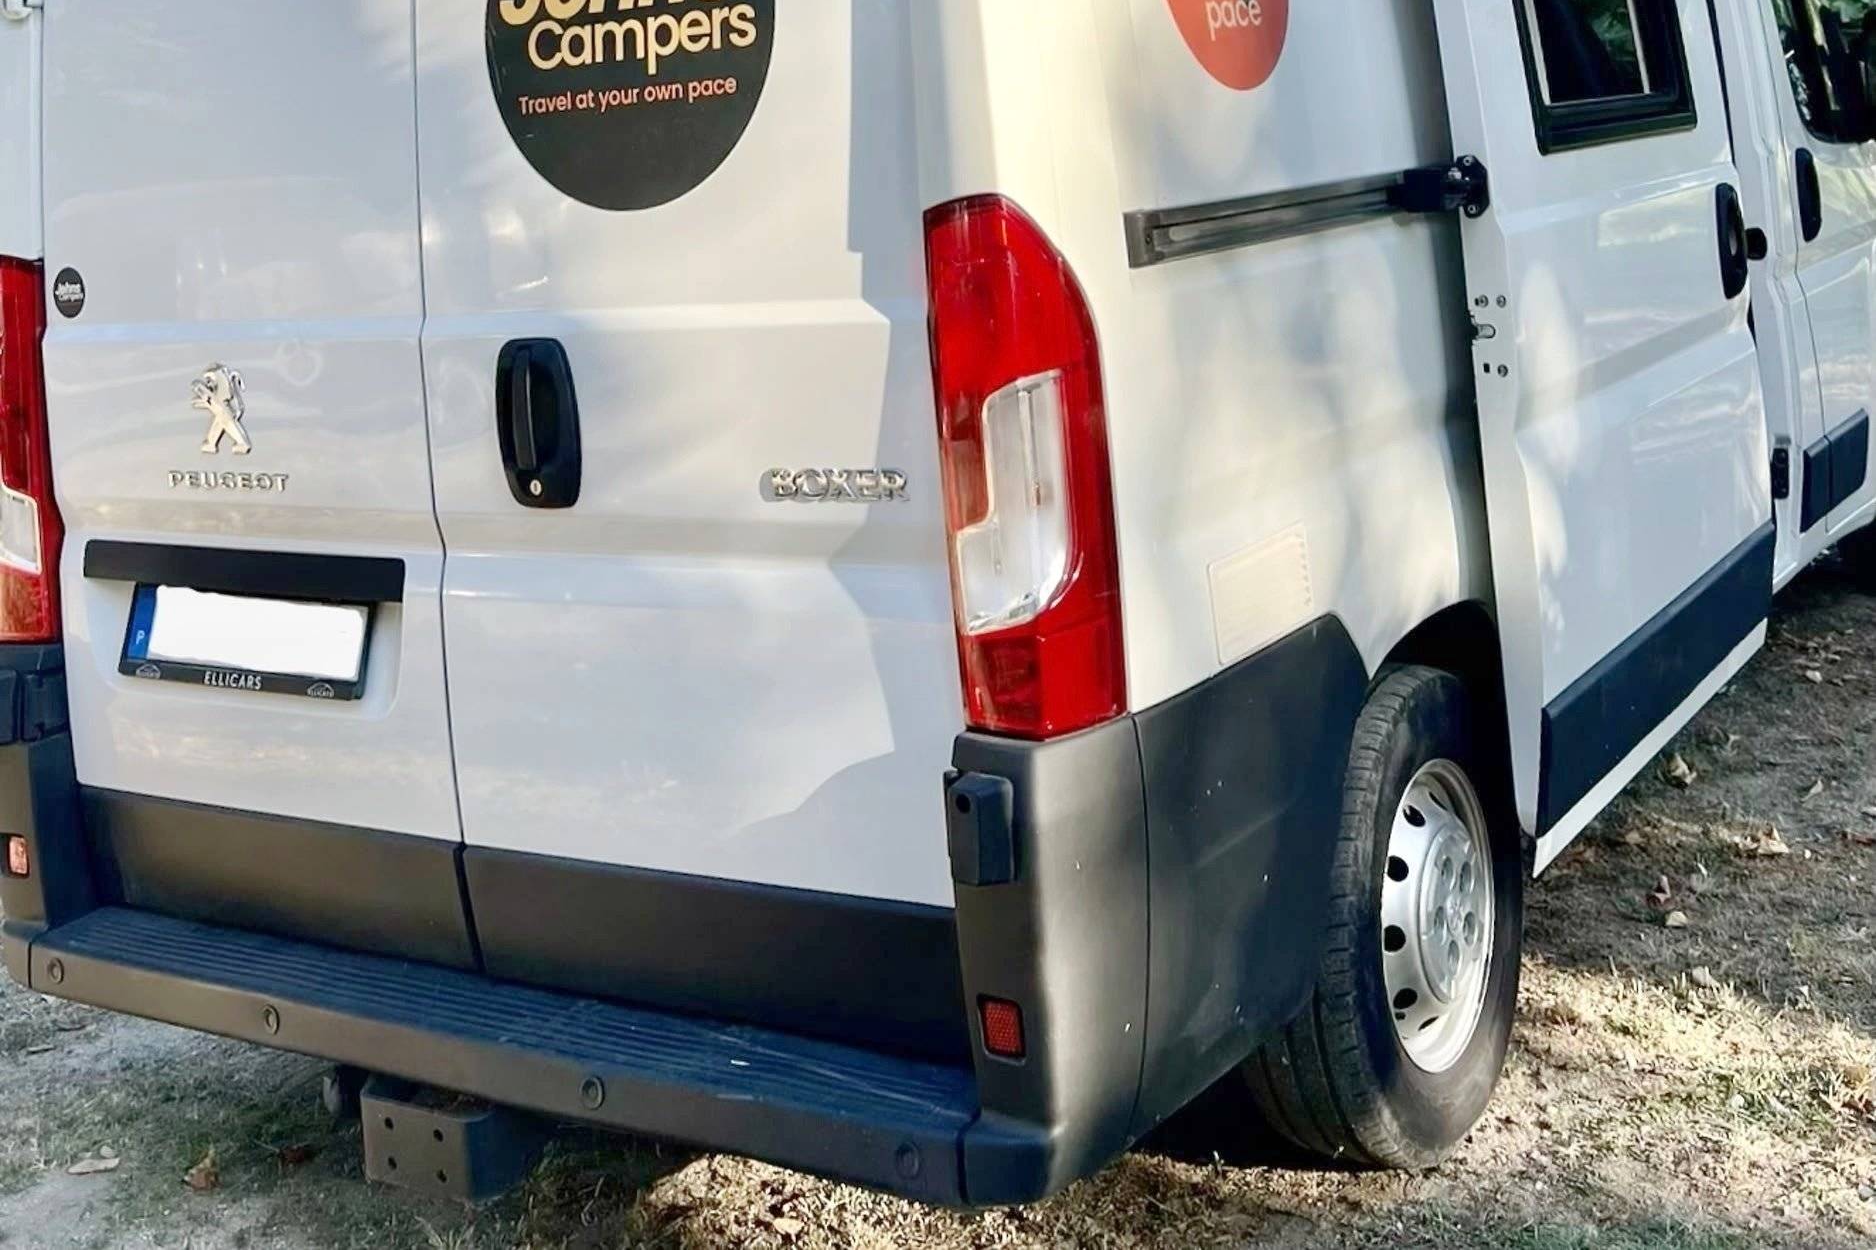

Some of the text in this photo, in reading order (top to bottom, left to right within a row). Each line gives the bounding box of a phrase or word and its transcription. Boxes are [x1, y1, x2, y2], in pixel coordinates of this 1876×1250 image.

[527, 3, 757, 76] Campers
[518, 76, 738, 116] Travel at your own pace
[168, 469, 290, 492] PEUGEOT
[760, 468, 911, 503] BOXER
[135, 629, 146, 645] P
[203, 670, 263, 691] ELLICARS
